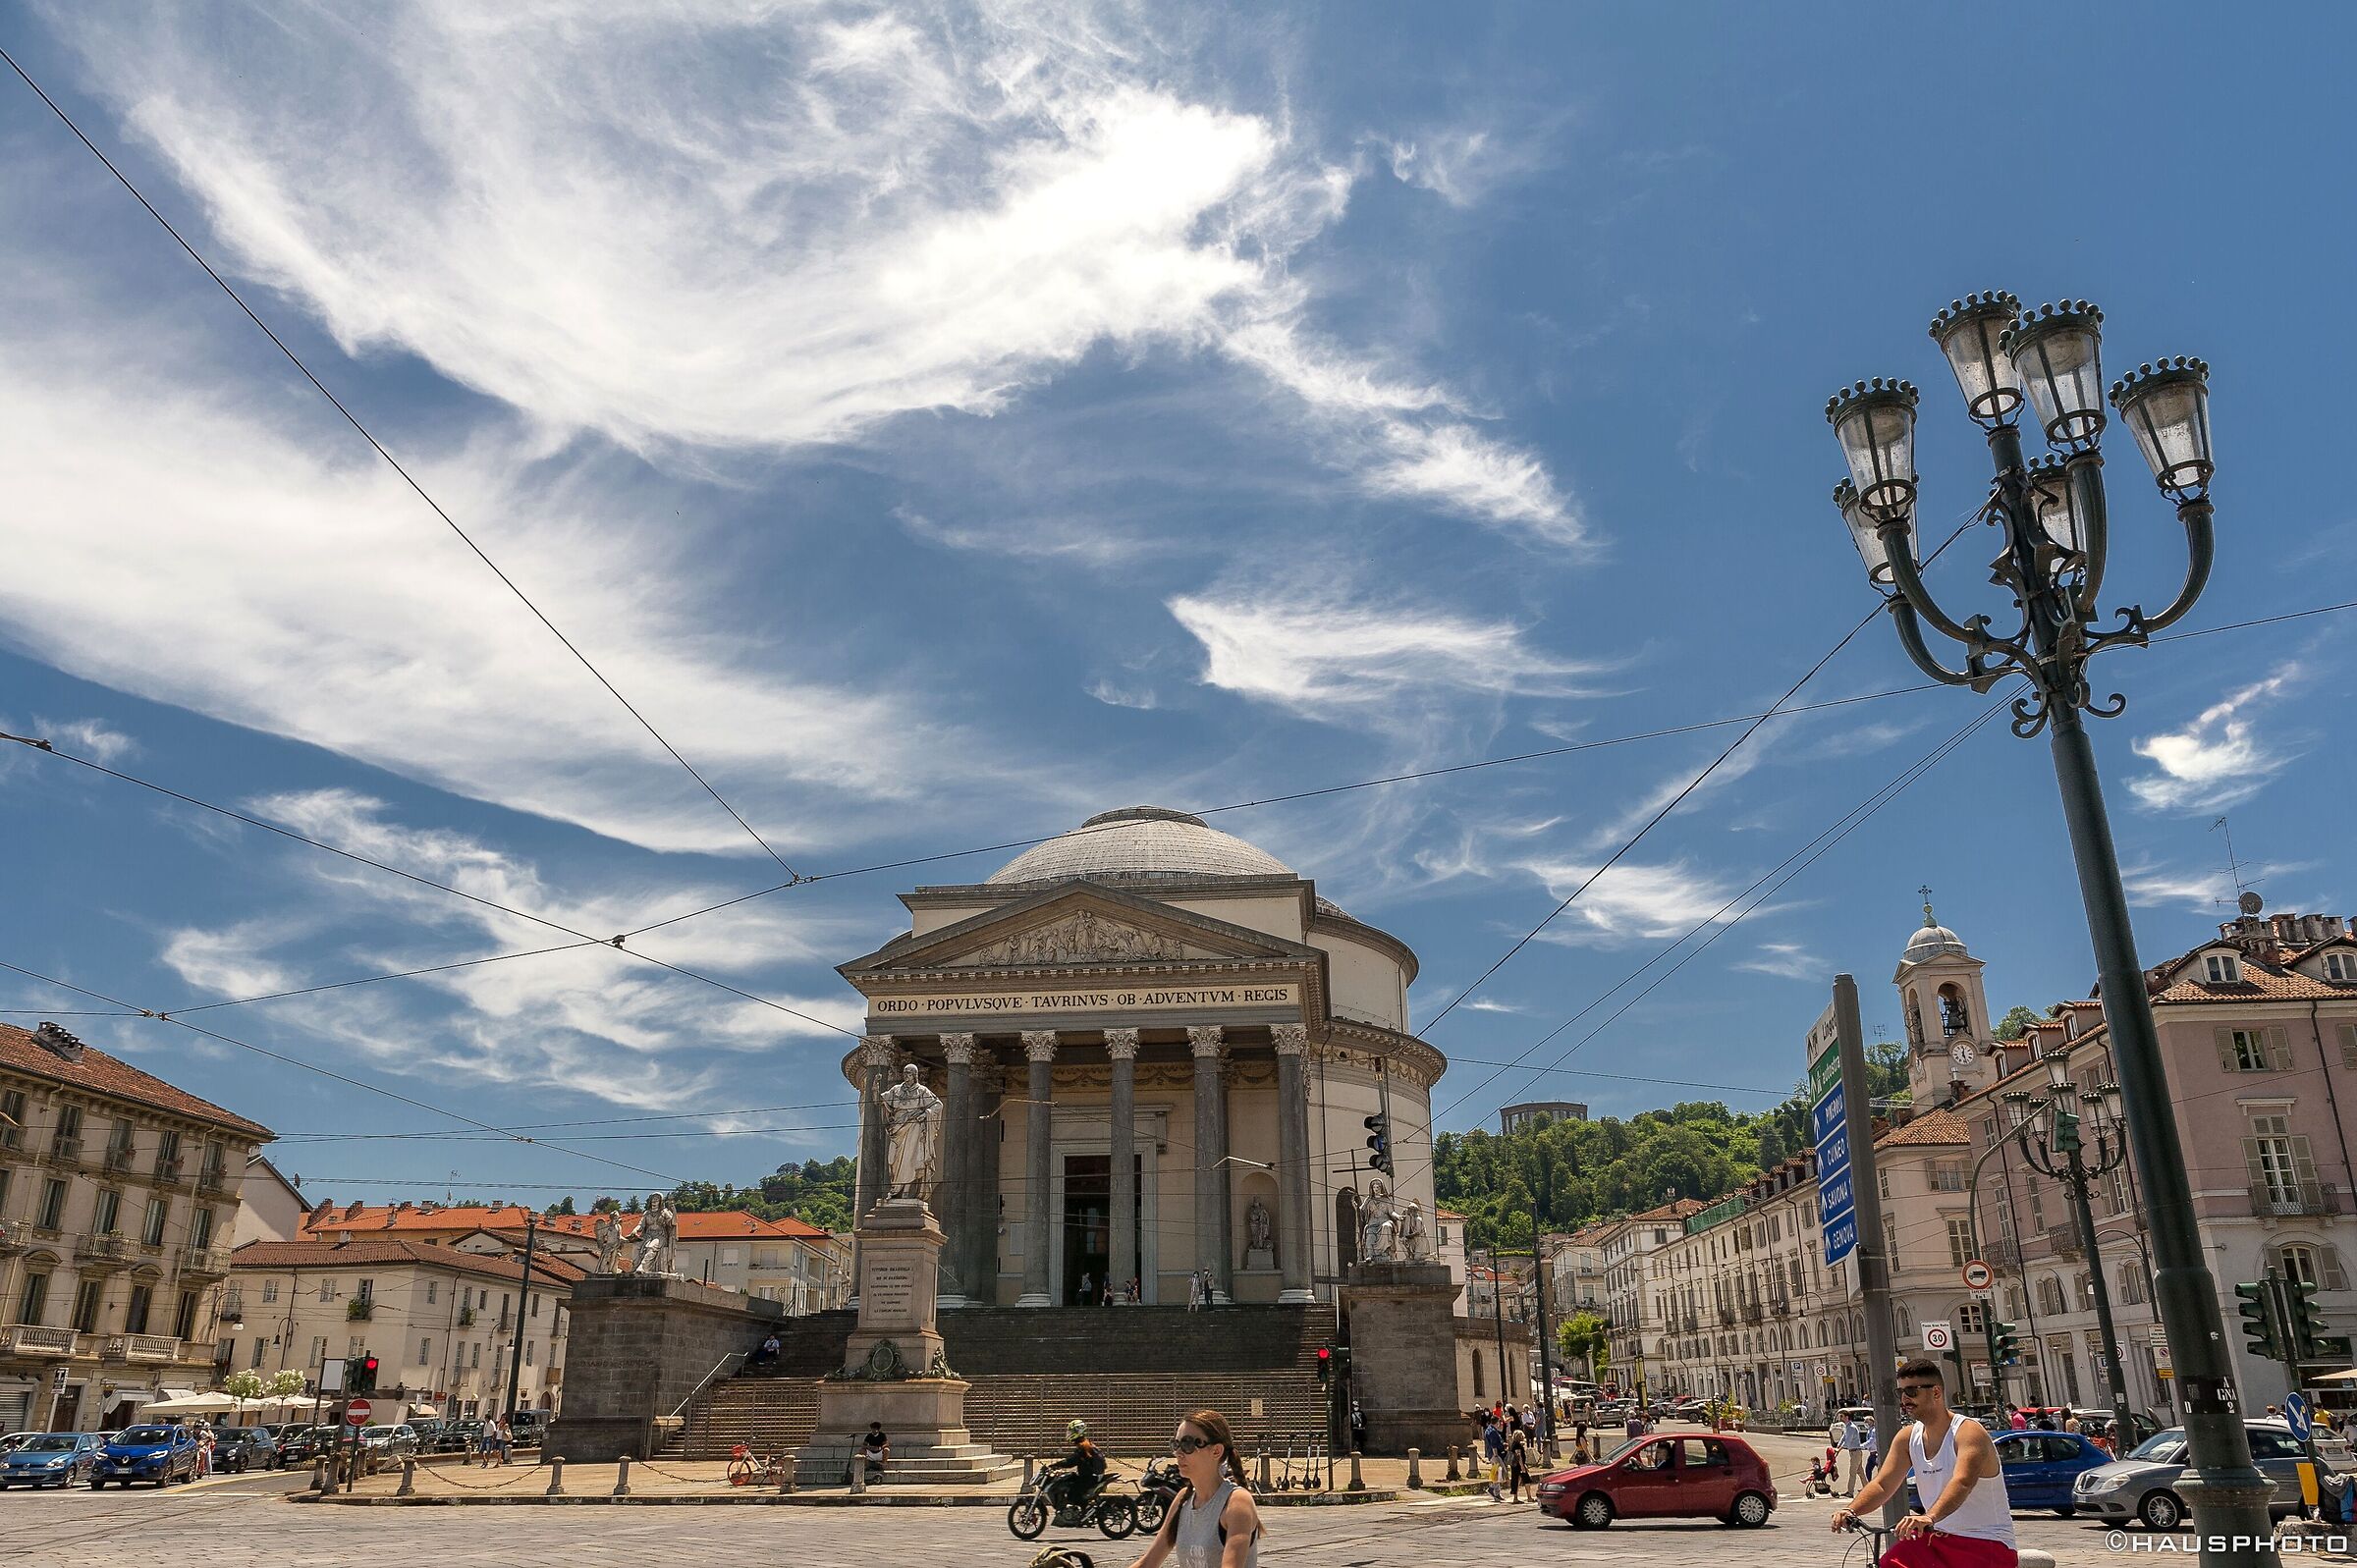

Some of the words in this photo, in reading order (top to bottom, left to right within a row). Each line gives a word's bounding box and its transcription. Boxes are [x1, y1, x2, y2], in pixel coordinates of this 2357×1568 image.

[878, 1000, 918, 1012] ORDO
[926, 997, 1022, 1010] POPVLVSQVE
[1031, 994, 1109, 1008] TAVRINVS
[1117, 994, 1136, 1005] OB
[1143, 990, 1235, 1004] ADVENTVM
[1244, 989, 1288, 1001] REGIS
[1828, 1180, 1848, 1211] SAVONA
[1833, 1222, 1854, 1250] GENOVA
[1932, 1333, 1944, 1342] 30
